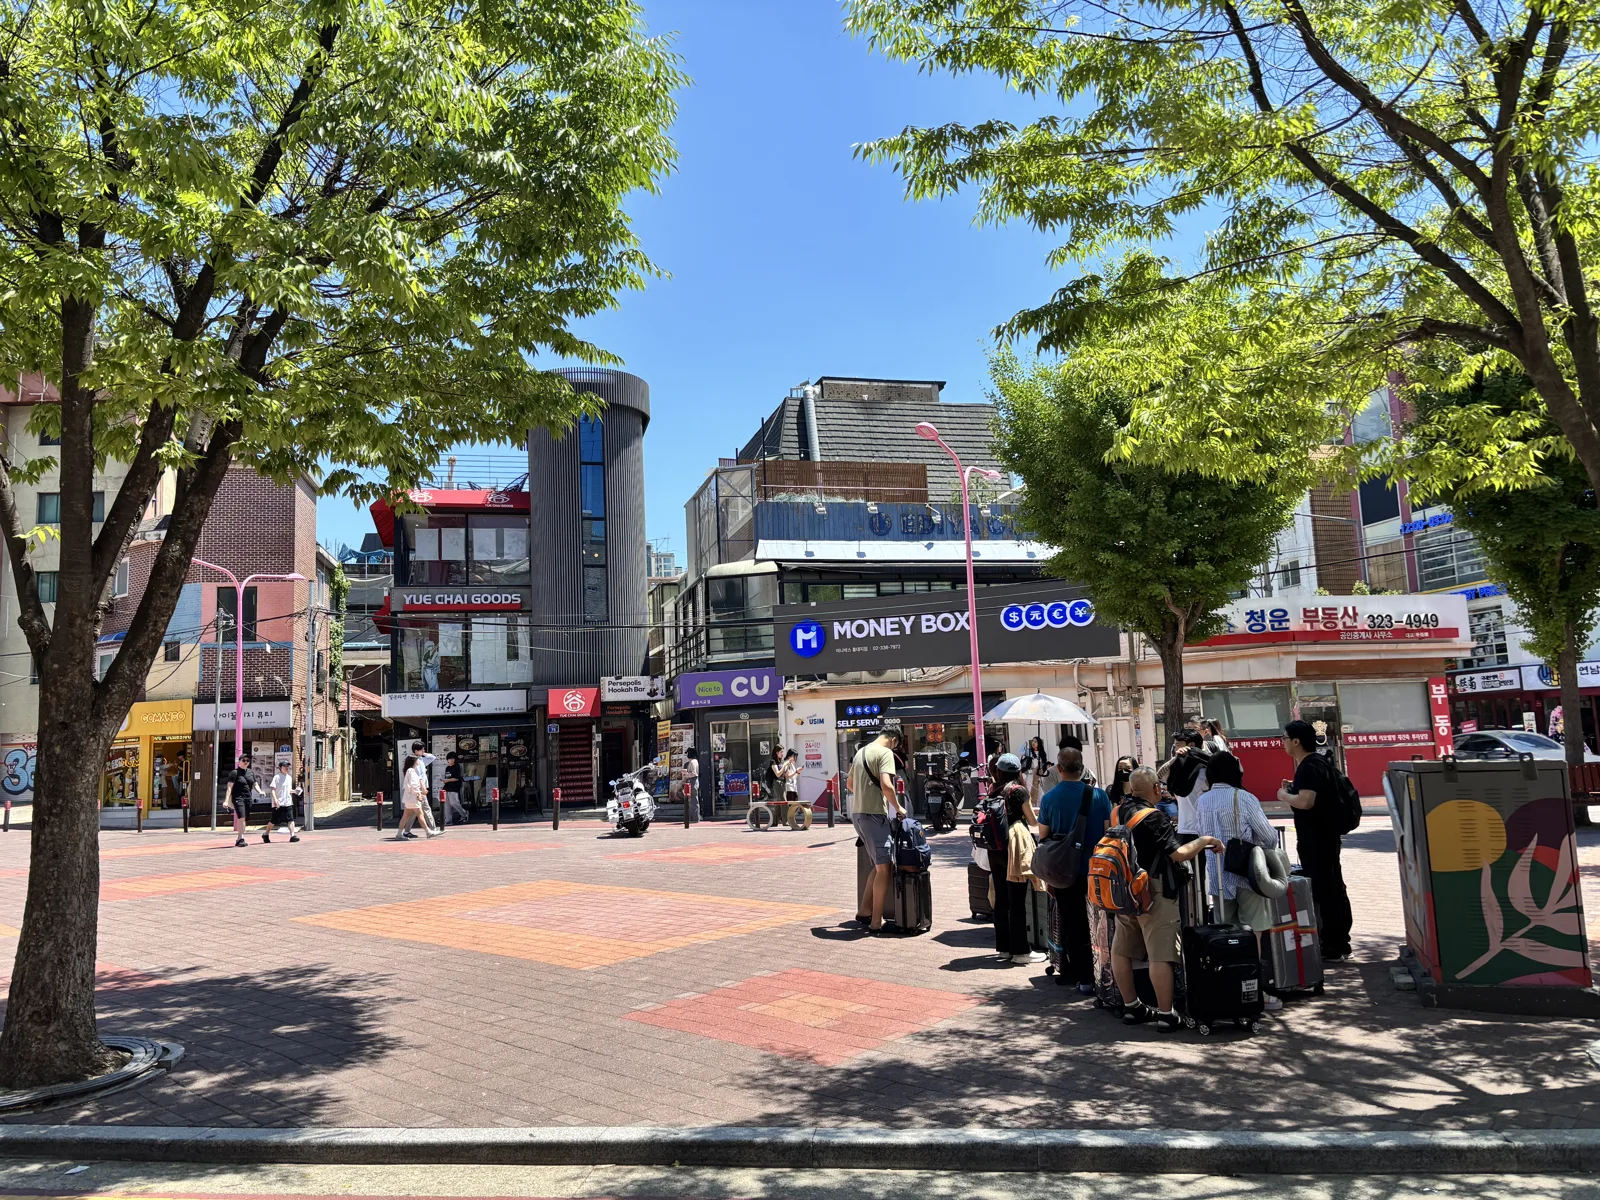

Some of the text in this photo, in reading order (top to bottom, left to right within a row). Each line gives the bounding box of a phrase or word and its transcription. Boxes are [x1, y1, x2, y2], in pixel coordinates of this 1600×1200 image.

[404, 593, 521, 605] YUE CHAI GOODS
[833, 611, 971, 640] MONEY BOX
[1245, 608, 1290, 632] 청운
[1302, 606, 1359, 629] 부동산
[1367, 613, 1439, 629] 323-4949
[731, 675, 770, 698] CU
[837, 719, 856, 728] SELF
